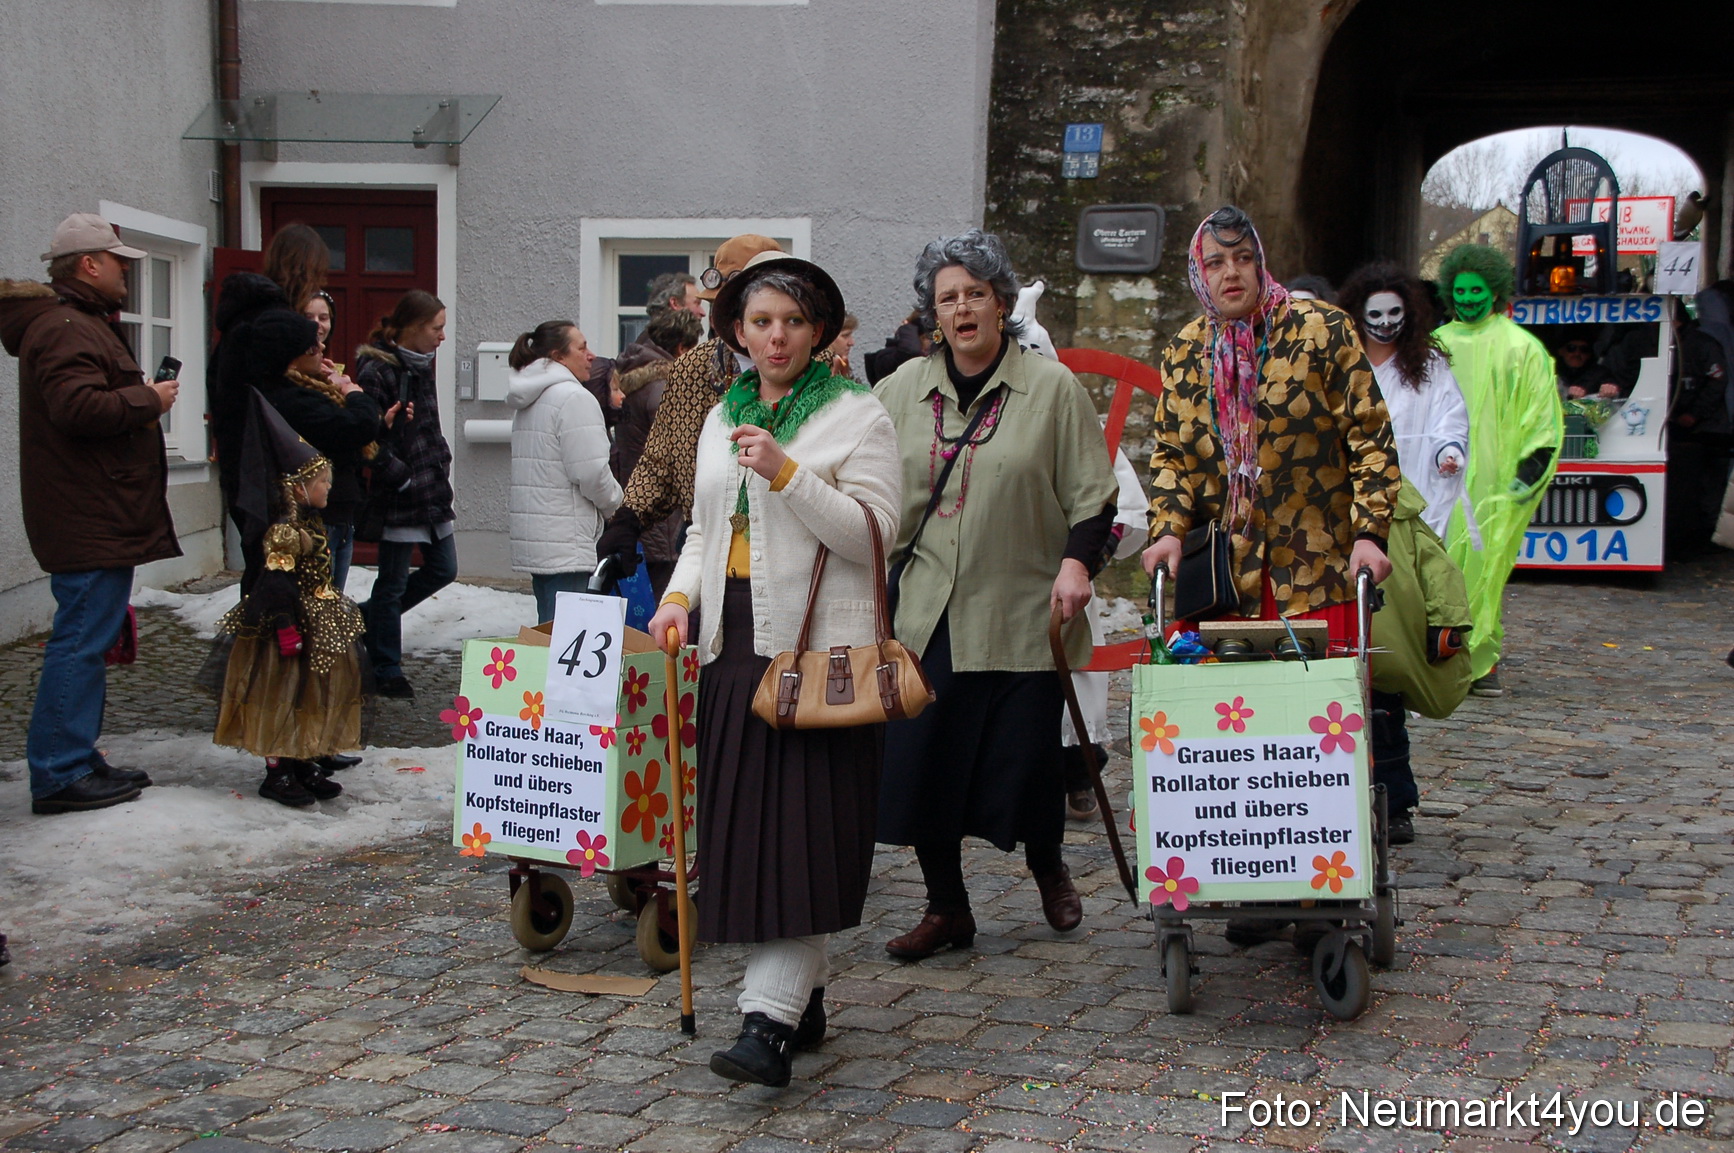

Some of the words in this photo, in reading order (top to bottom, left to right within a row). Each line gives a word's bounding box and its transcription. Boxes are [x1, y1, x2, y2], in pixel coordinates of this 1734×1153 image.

[1074, 127, 1094, 141] 13
[1663, 256, 1694, 276] 44
[462, 362, 471, 370] 12
[557, 629, 612, 679] 43
[485, 721, 539, 742] Graues
[544, 727, 584, 750] Haar,
[466, 743, 527, 765] Rollator
[531, 751, 603, 774] schieben
[1177, 746, 1255, 764] Graues
[1263, 743, 1320, 763] Haar,
[494, 774, 523, 789] und
[528, 774, 573, 795] übers
[1151, 774, 1240, 793] Rollator
[1247, 770, 1350, 790] schieben
[466, 791, 601, 823] Kopfsteinpflaster
[1195, 801, 1237, 820] und
[1244, 800, 1309, 818] übers
[501, 820, 561, 843] fliegen!
[1155, 826, 1352, 852] Kopfsteinpflaster
[1210, 855, 1297, 878] fliegen!
